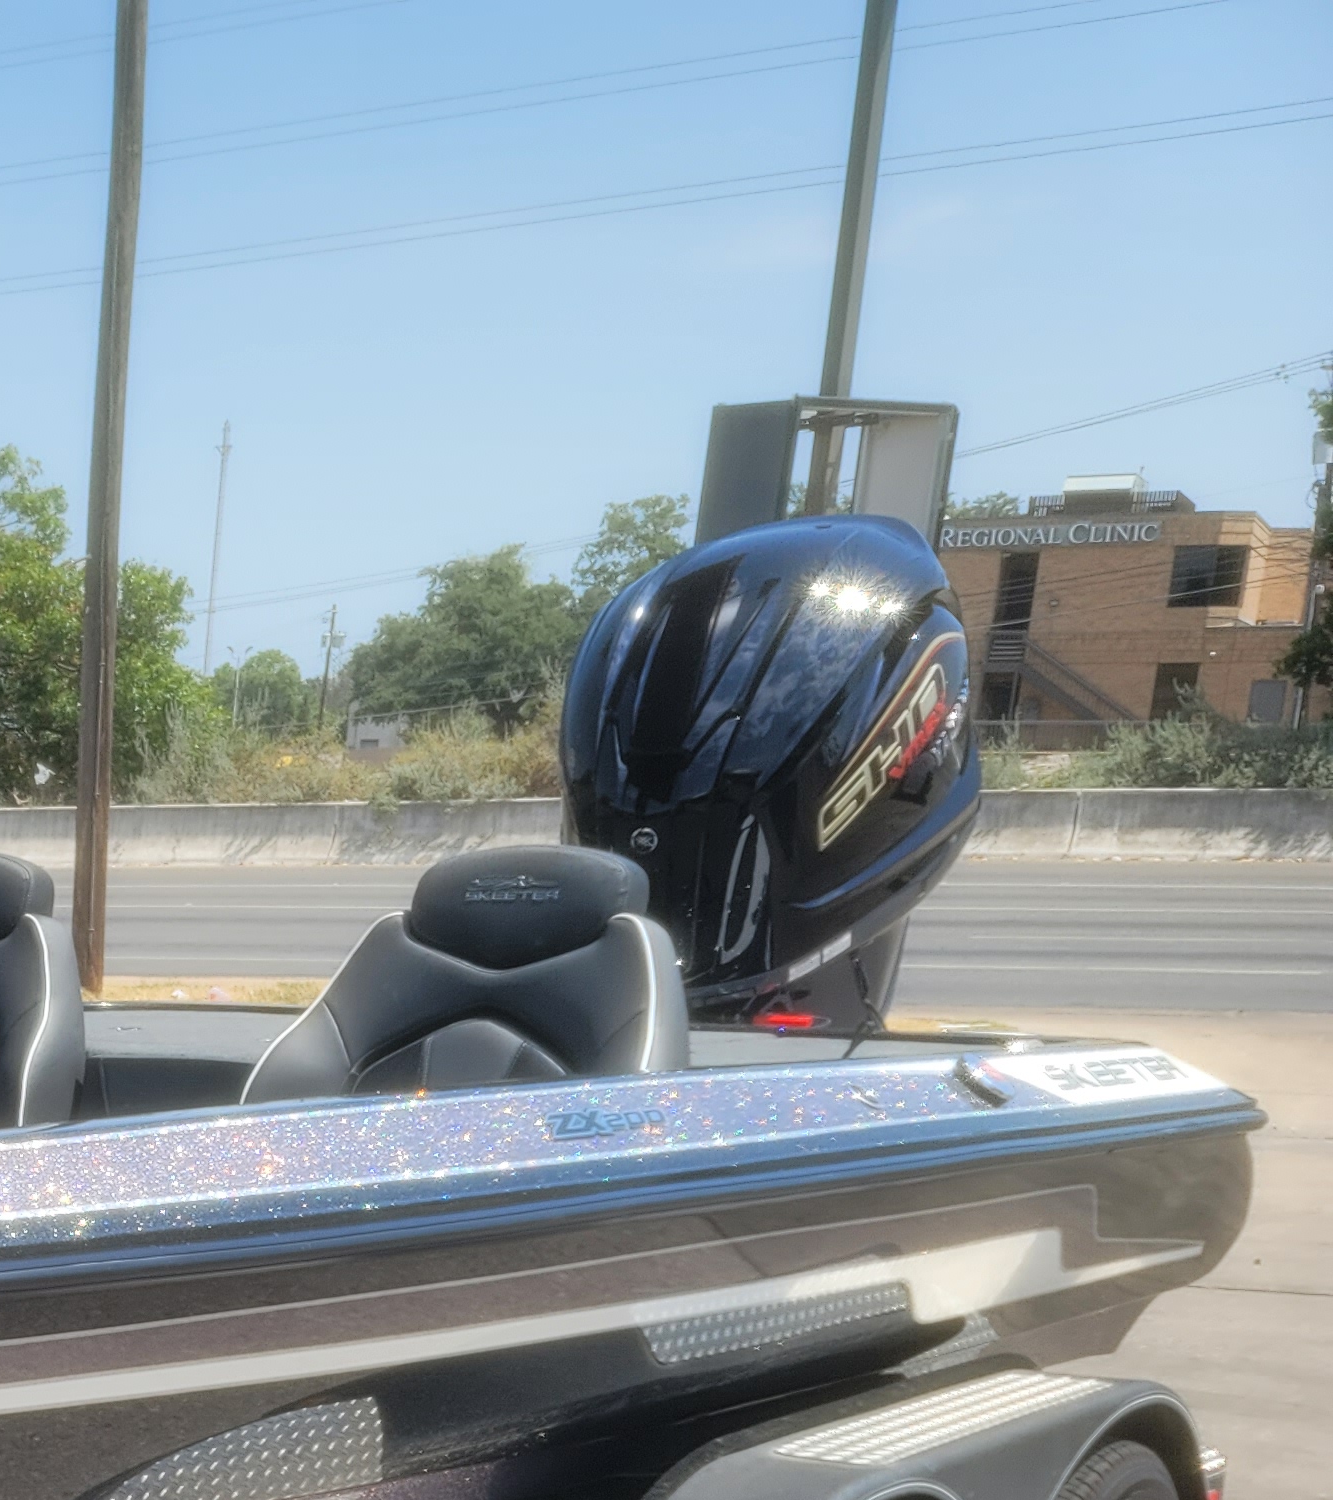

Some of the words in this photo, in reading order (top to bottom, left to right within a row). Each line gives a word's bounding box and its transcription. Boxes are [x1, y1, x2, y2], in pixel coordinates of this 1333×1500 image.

[940, 527, 1062, 548] REGIONAL
[1068, 523, 1158, 545] CLINIC
[464, 889, 561, 901] SKEETER
[1043, 1055, 1190, 1091] SKEETER
[546, 1109, 665, 1136] ZX200
